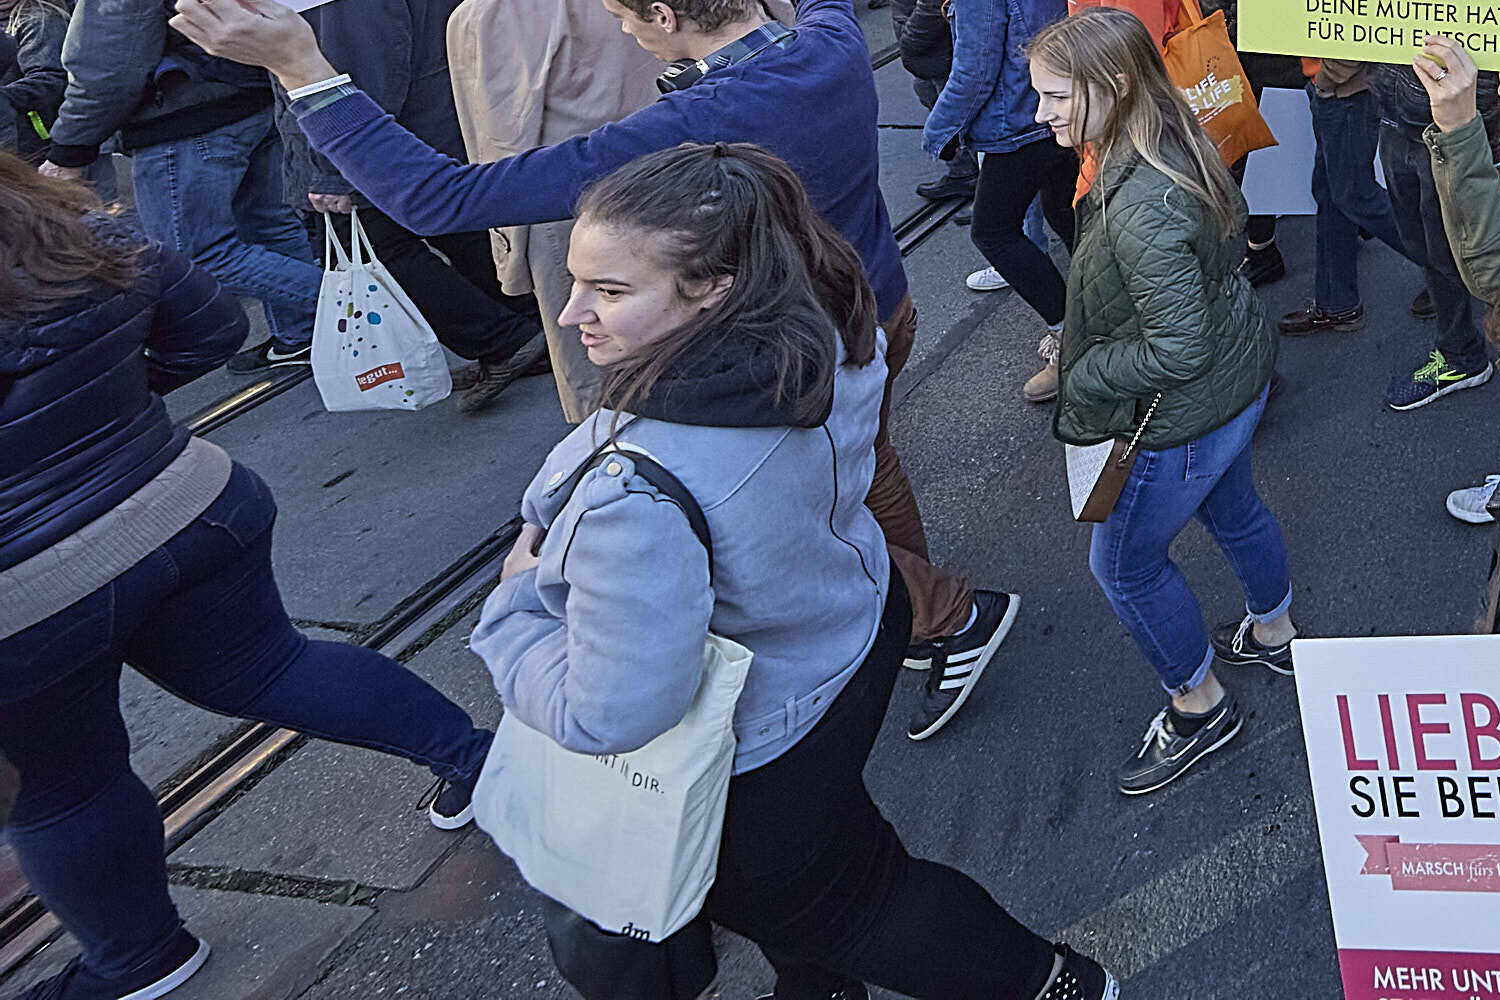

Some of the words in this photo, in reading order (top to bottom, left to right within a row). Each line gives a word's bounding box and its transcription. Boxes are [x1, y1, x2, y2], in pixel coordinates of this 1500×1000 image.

[1376, 0, 1458, 24] MUTTER
[1307, 16, 1345, 41] FÜR
[1353, 27, 1403, 46] DICH
[1185, 72, 1217, 101] LIFE
[1203, 79, 1231, 108] LIFE
[632, 772, 665, 794] DIR.
[1349, 775, 1421, 818] SIE
[1402, 861, 1465, 877] MARSCH
[1469, 857, 1494, 882] fürs
[622, 922, 650, 941] dm
[1374, 965, 1445, 993] MEHR
